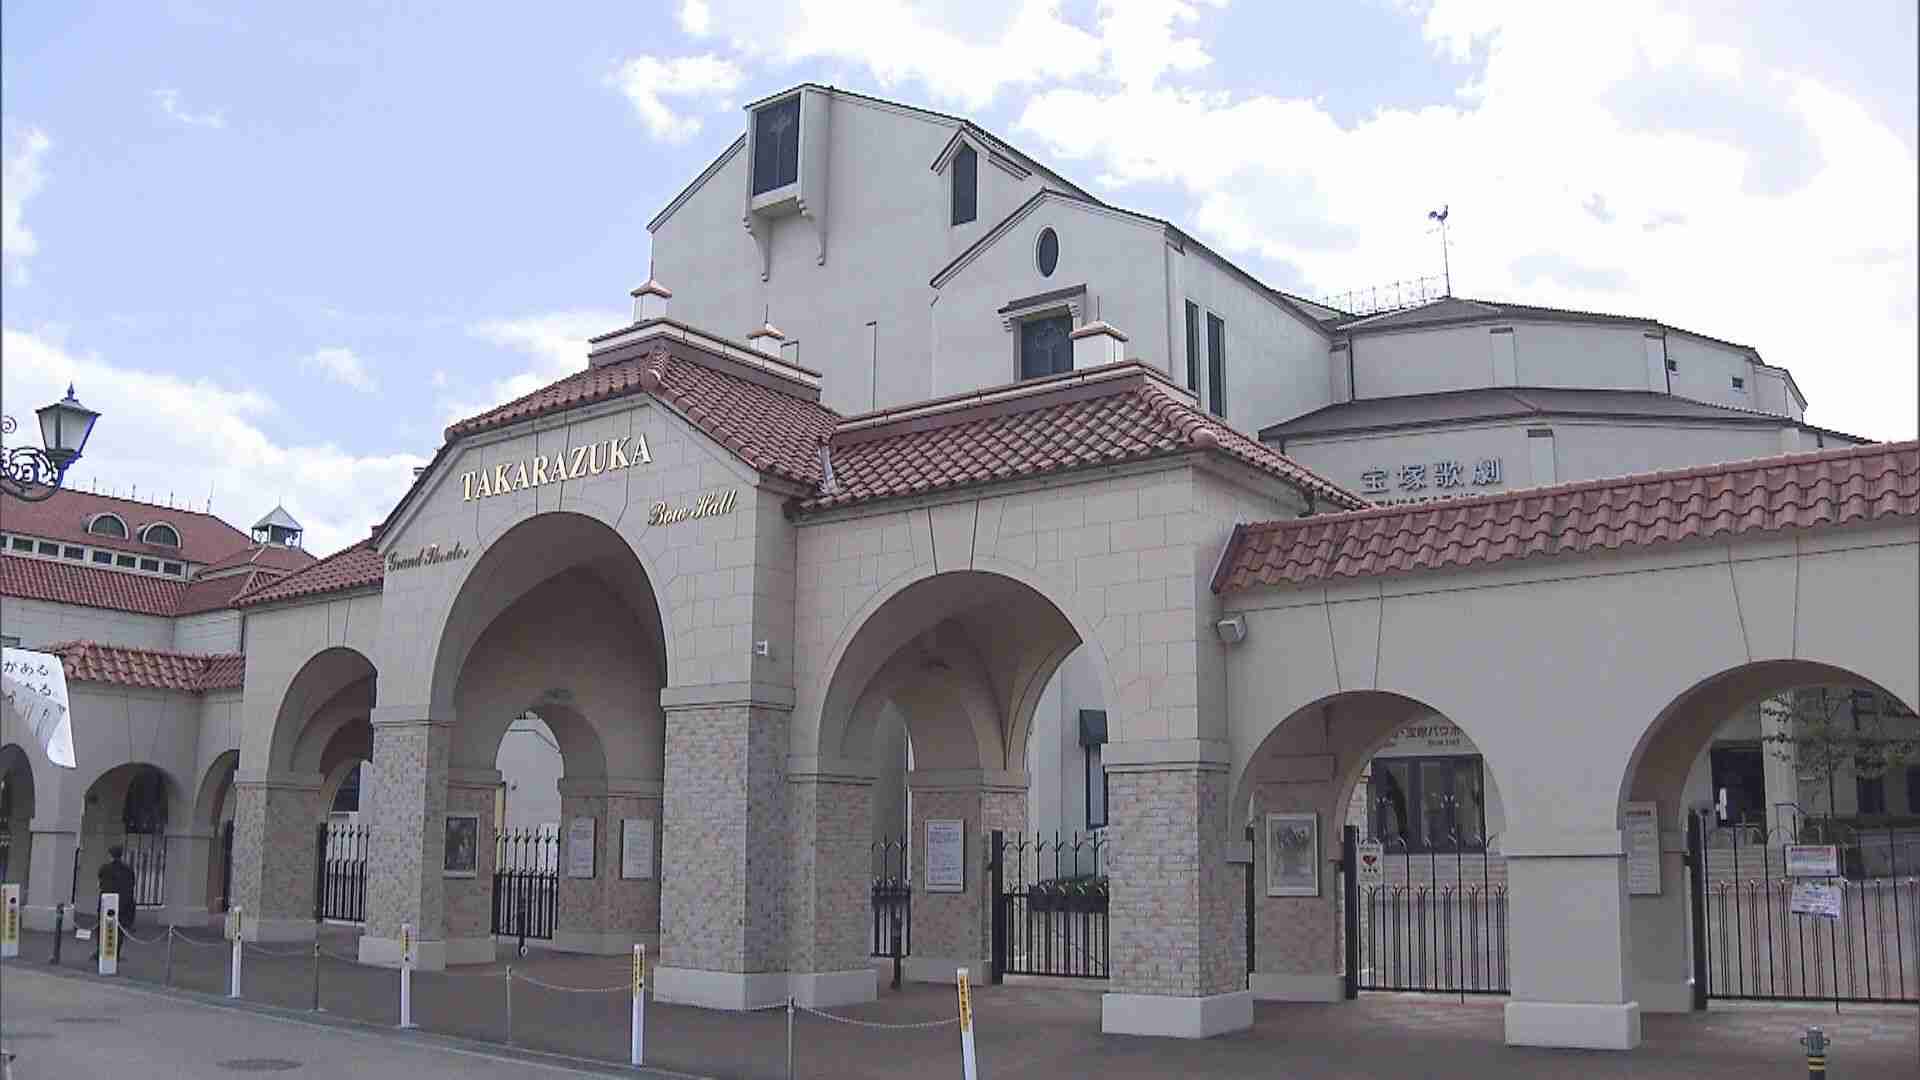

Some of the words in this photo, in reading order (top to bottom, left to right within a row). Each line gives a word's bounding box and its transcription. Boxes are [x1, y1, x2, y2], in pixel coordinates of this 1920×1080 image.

[461, 434, 653, 501] TAKARAZUKA
[1361, 457, 1504, 494] 宝塚歌劇
[648, 501, 688, 526] Bow
[690, 489, 737, 519] Hall
[388, 546, 424, 571] Grand
